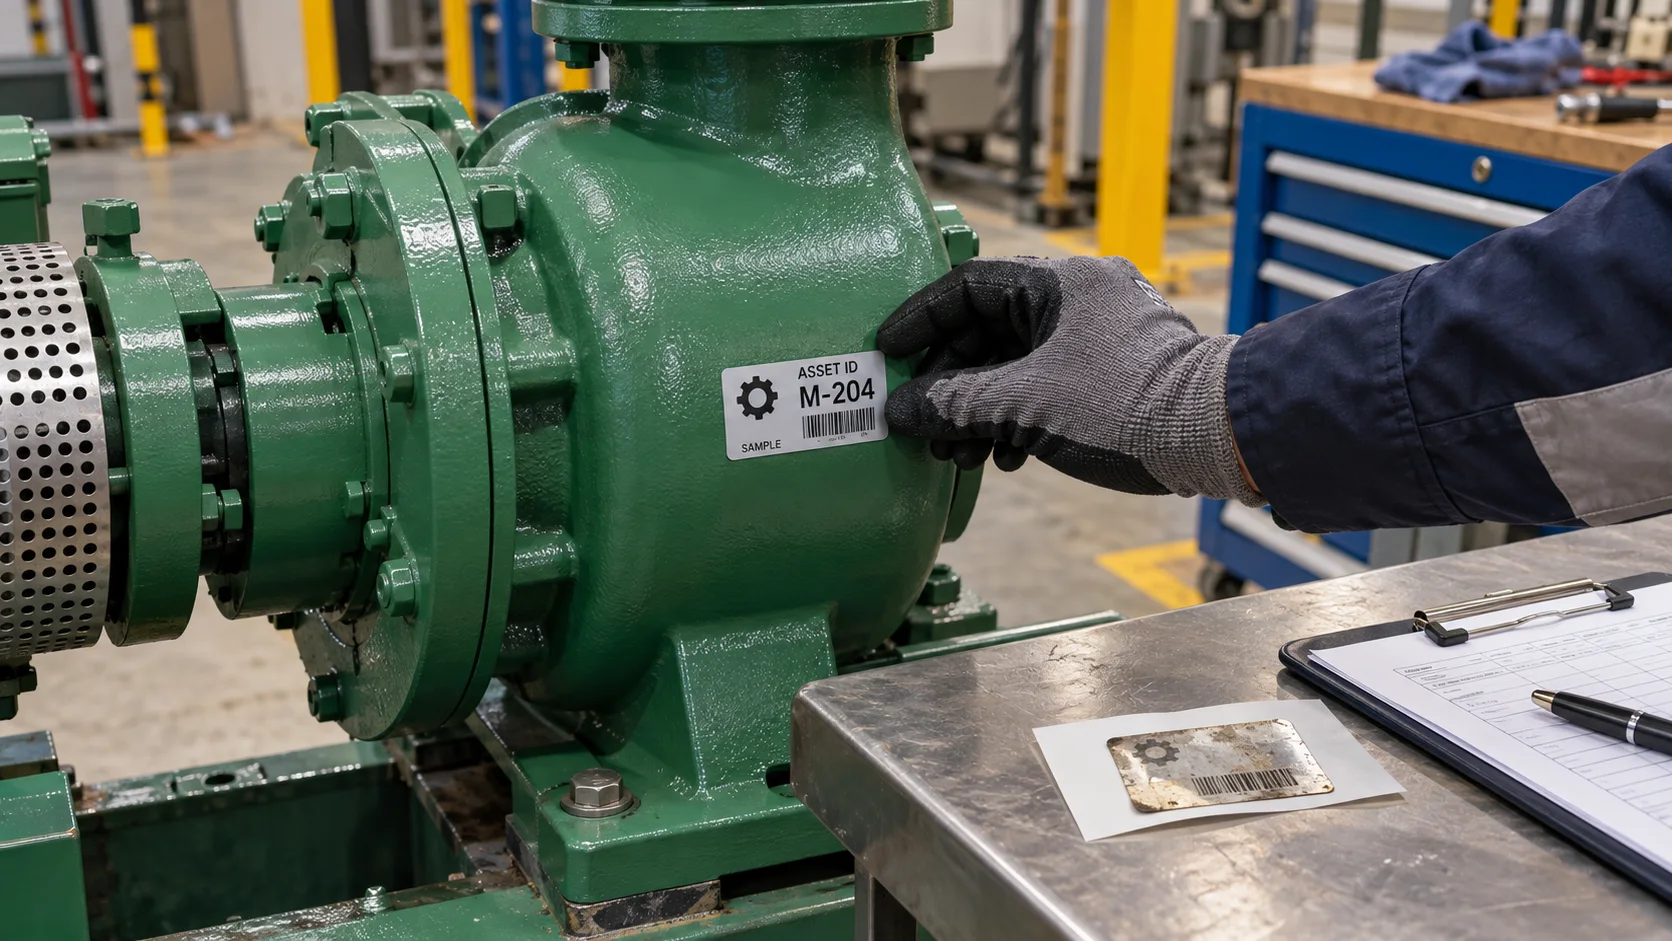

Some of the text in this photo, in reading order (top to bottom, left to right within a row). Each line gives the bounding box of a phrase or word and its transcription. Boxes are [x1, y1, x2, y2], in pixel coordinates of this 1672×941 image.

[798, 360, 858, 379] ASSET ID
[799, 378, 875, 409] M-204
[741, 439, 782, 453] SAMPLE
